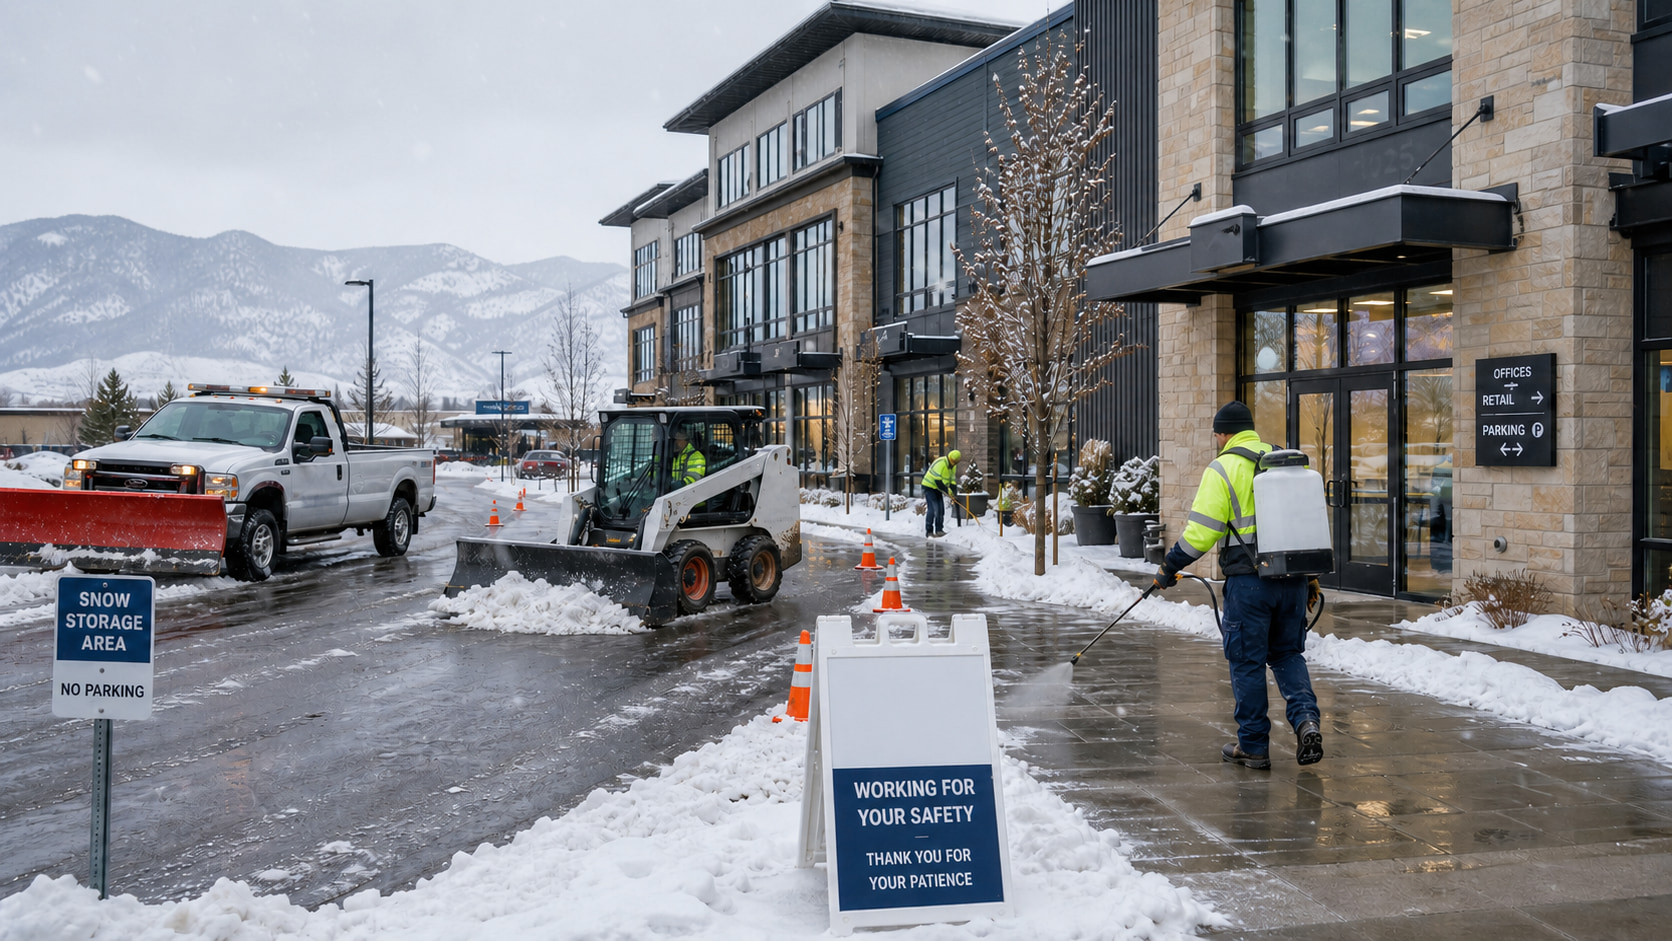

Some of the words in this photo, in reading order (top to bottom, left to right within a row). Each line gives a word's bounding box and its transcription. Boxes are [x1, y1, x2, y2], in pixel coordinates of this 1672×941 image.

[1493, 366, 1532, 379] OFFICES
[1482, 394, 1515, 406] RETAIL
[1482, 424, 1526, 436] PARKING
[79, 591, 131, 608] SNOW
[65, 613, 143, 630] STORAGE
[81, 635, 127, 651] AREA
[61, 683, 81, 696] NO
[85, 684, 144, 698] PARKING
[854, 780, 937, 799] WORKING
[941, 778, 976, 796] FOR
[857, 808, 906, 826] YOUR
[910, 805, 974, 824] SAFETY
[866, 850, 912, 866] THANK
[914, 849, 942, 864] YOU
[945, 848, 972, 863] FOR
[869, 875, 906, 890] YOUR
[909, 872, 973, 889] PATIENCE
